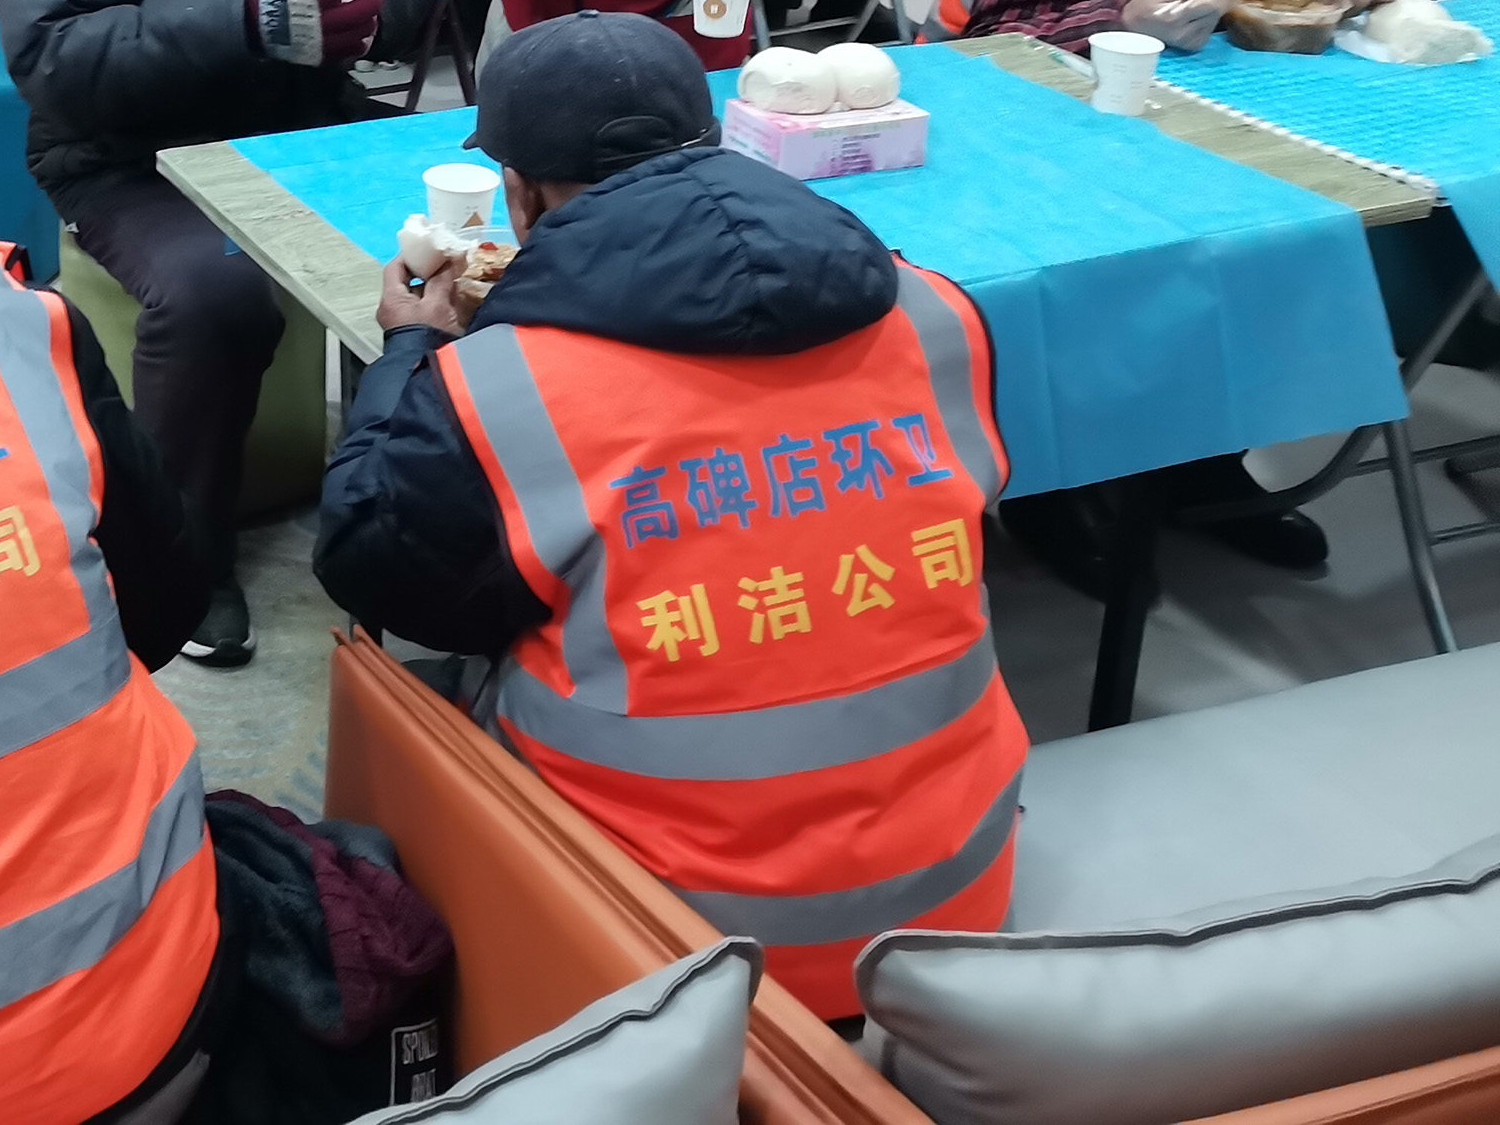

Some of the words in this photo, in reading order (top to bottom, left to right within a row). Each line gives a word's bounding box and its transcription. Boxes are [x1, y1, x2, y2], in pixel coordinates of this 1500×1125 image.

[608, 412, 954, 550] 高碑店环卫
[636, 517, 974, 663] 利洁公司
